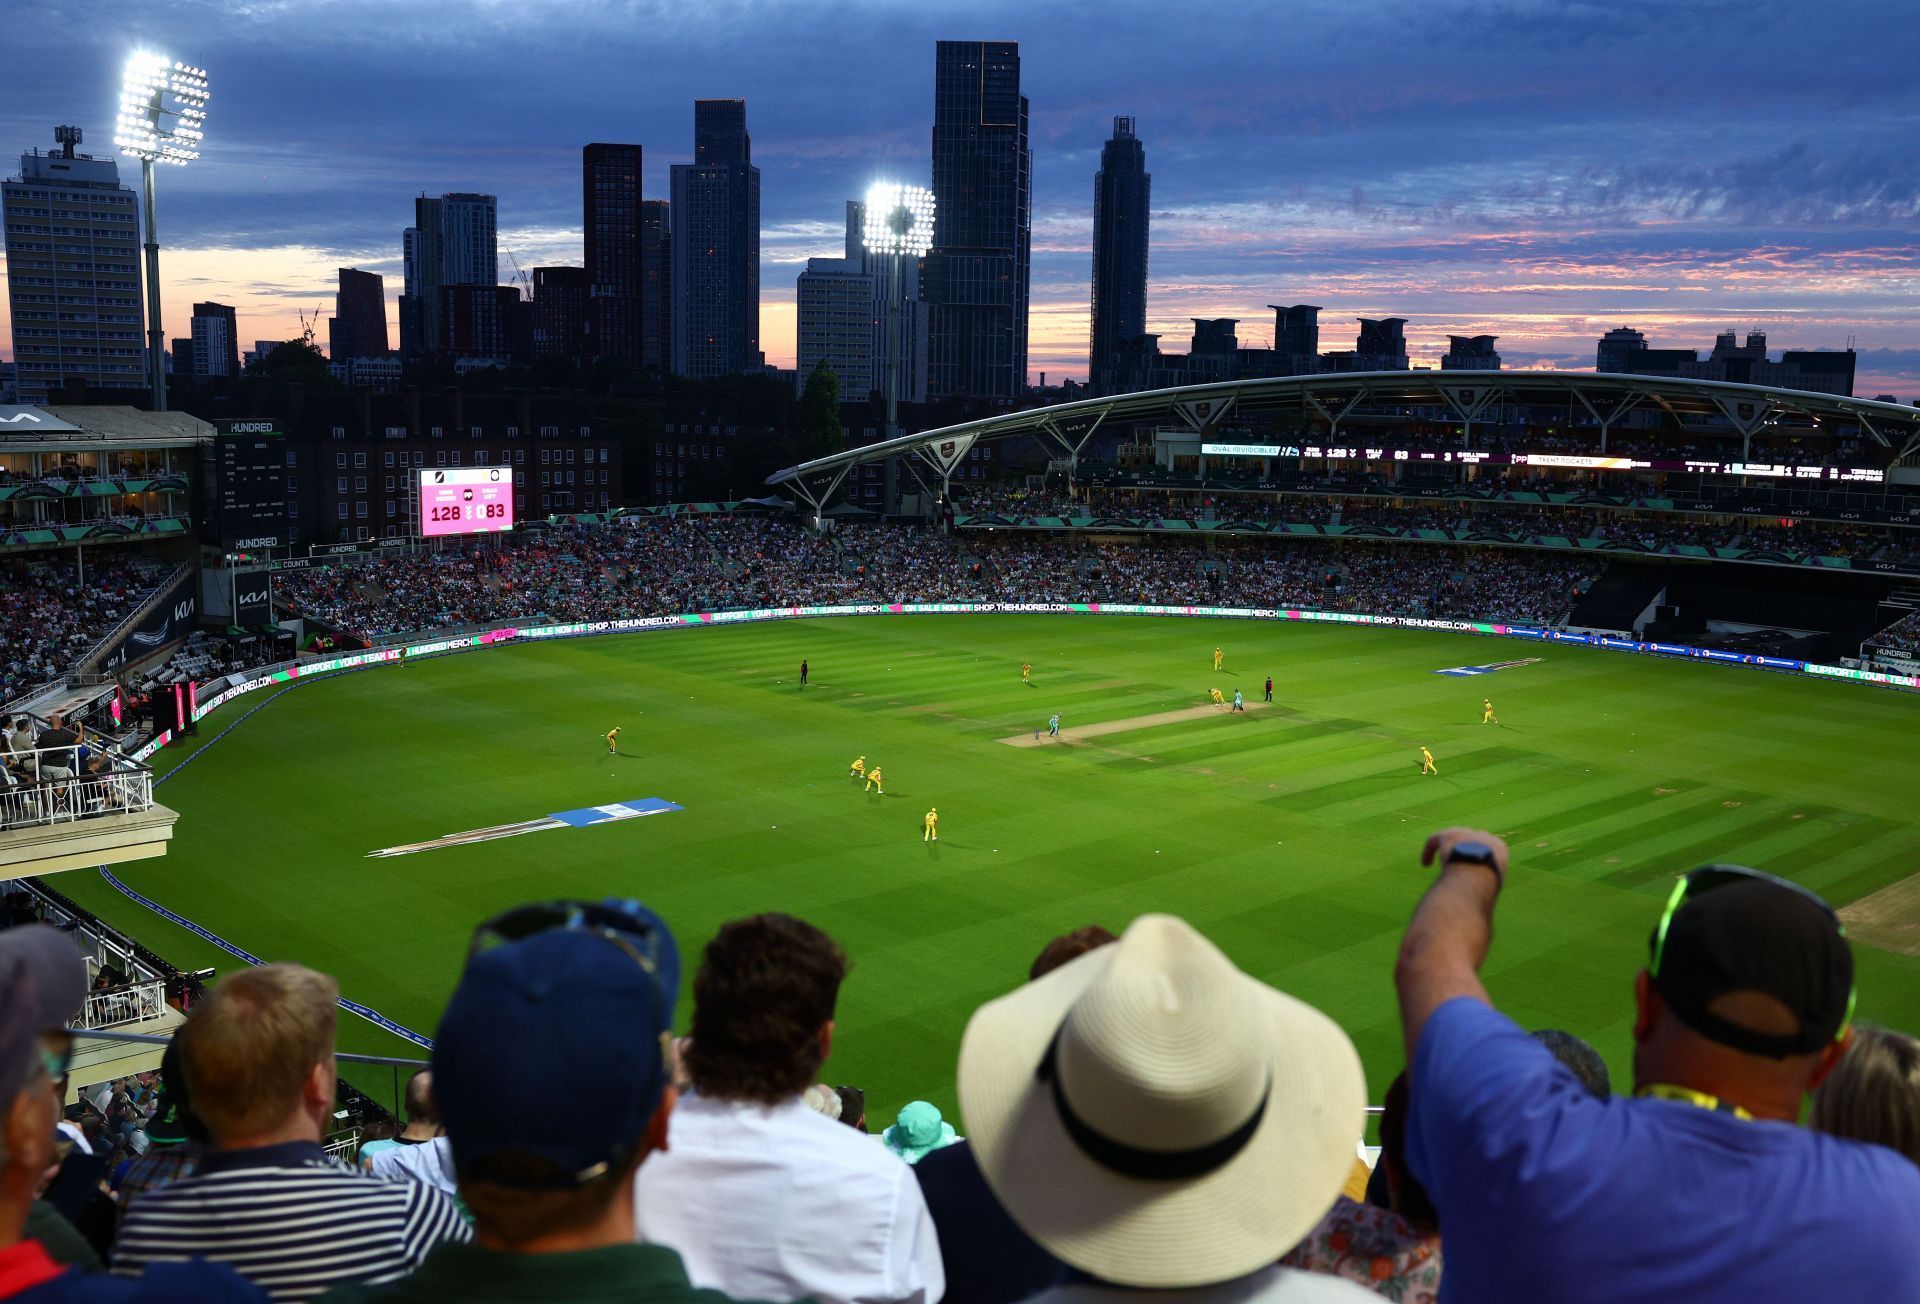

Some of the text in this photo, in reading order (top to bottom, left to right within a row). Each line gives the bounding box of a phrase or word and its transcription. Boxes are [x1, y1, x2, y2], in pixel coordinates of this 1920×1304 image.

[231, 422, 273, 433] HUNDRED
[431, 506, 460, 521] 128
[235, 537, 277, 549] HUNDRED
[329, 545, 357, 553] HUNDRED
[378, 538, 406, 547] HUNDRED
[283, 559, 311, 568] COUNTS.
[239, 590, 268, 604] KIA
[175, 597, 194, 621] KIA
[713, 605, 882, 620] SUPPORT YOUR TEAM WITH HUNDRED MERCH
[974, 603, 1067, 611] SHOP.THEHUNDRED.COM
[1102, 604, 1279, 618] SUPPORT YOUR TEAM WITH HUNDRED MERCH
[518, 615, 680, 637] ON SALE NOW AT SHOP.THEHUNDRED.COM
[1317, 612, 1338, 620] SALE
[1373, 616, 1471, 630] SHOP.THEHUNDRED.COM
[300, 638, 473, 675] SUPPORT YOUR TEAM WIH HUNDRED MERCH
[1876, 647, 1912, 659] HUNDRED
[1808, 664, 1917, 687] SUPPORT YOUR TEAM
[213, 675, 272, 708] SHOP.THEHUNDRED.COM
